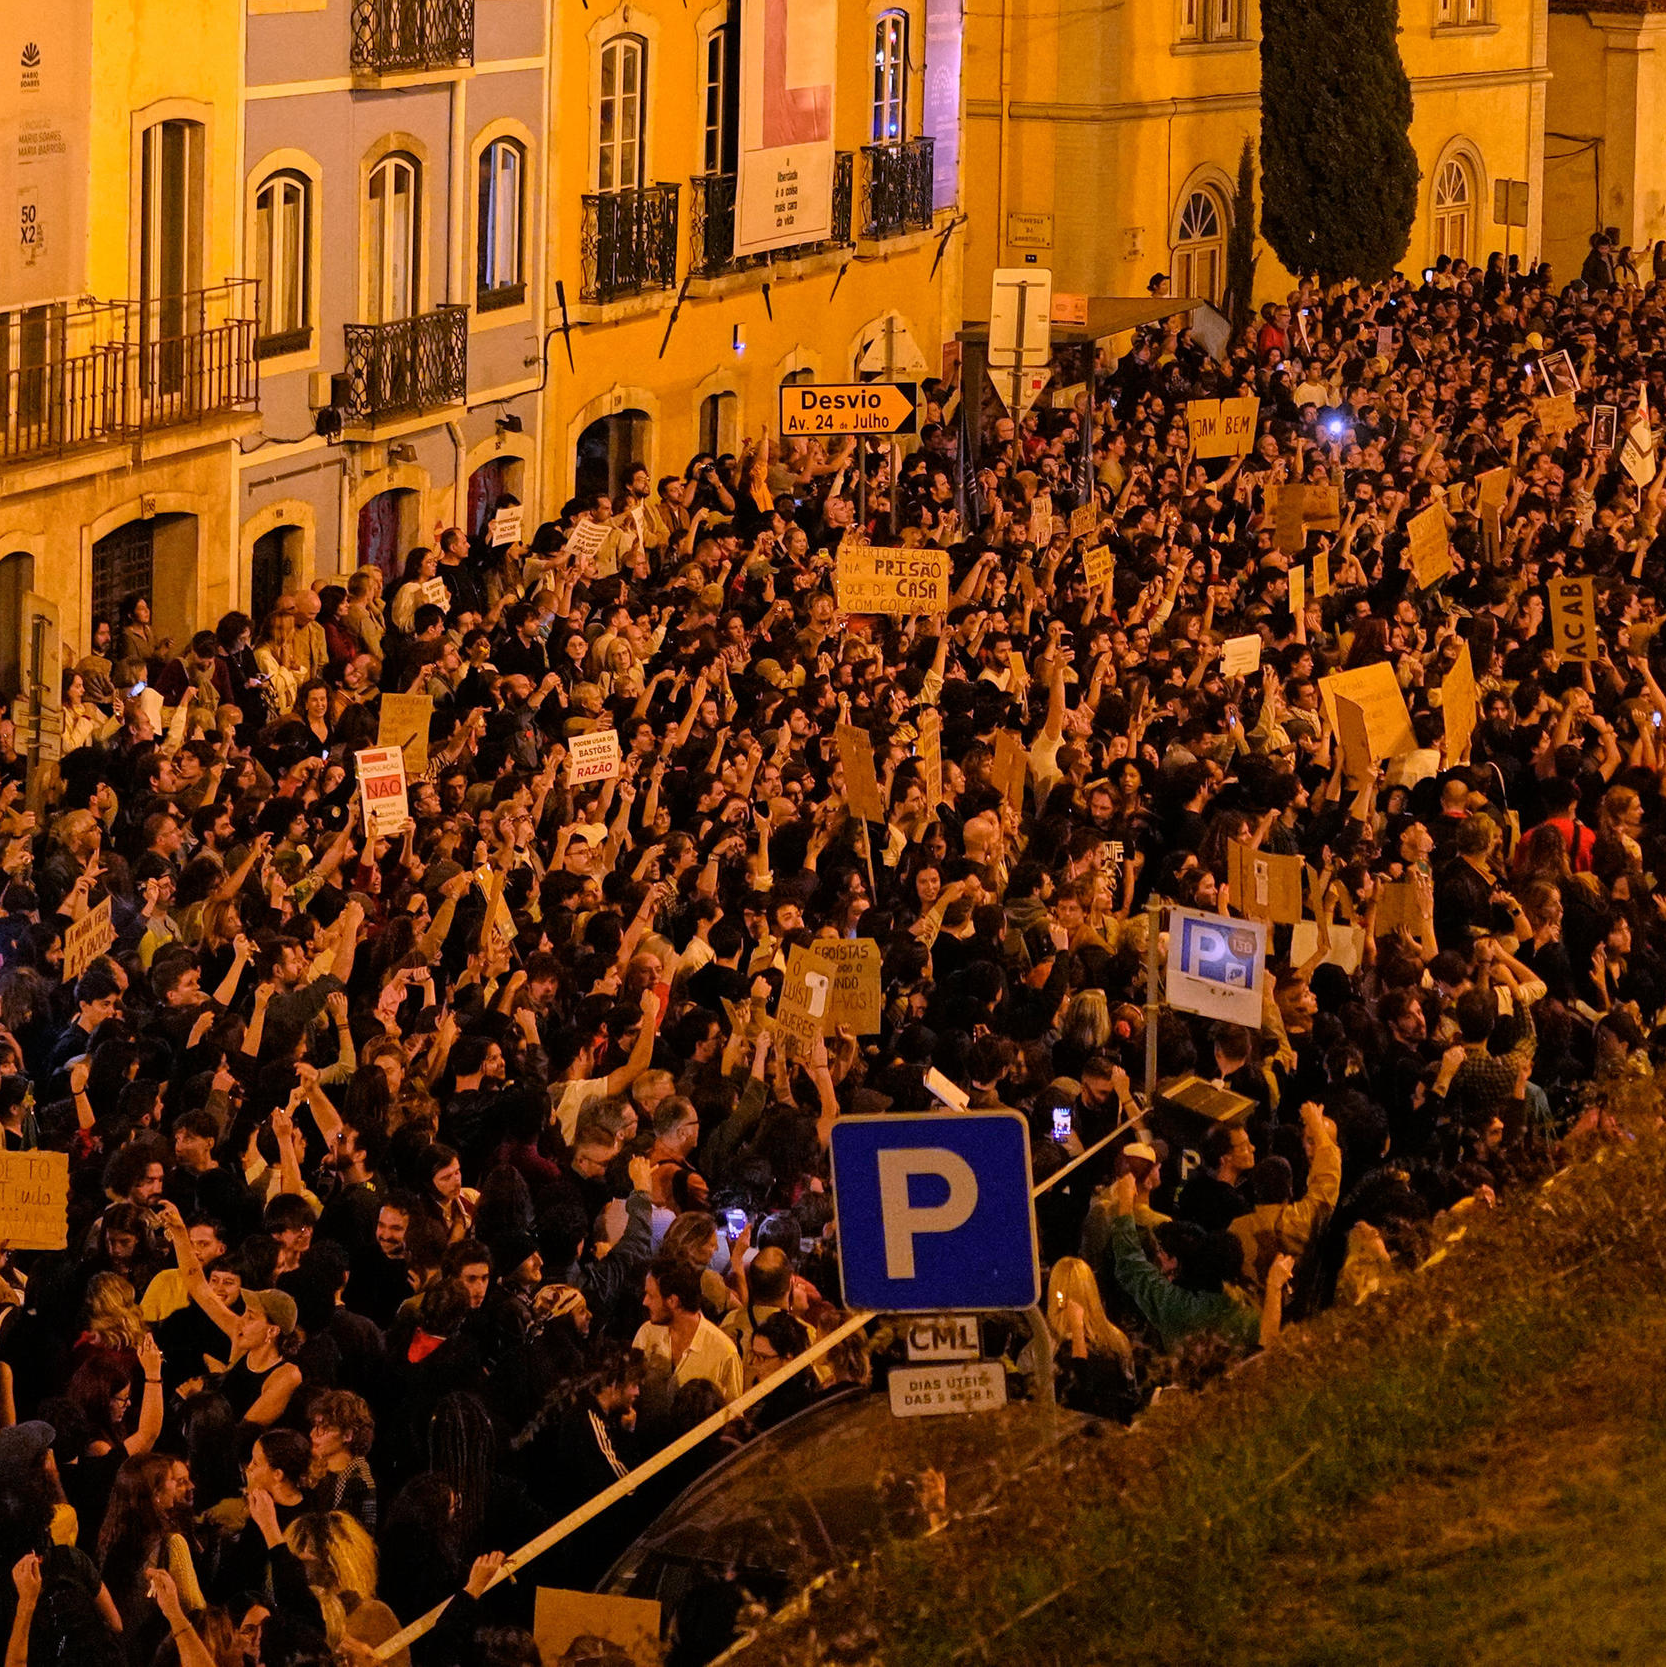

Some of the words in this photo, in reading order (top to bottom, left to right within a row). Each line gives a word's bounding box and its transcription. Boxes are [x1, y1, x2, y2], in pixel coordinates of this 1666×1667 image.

[21, 205, 36, 224] 50
[20, 225, 36, 245] X2
[801, 389, 881, 411] Desvio
[788, 415, 810, 431] Av.
[815, 414, 833, 430] 24
[840, 422, 848, 430] de
[853, 413, 890, 430] Julho
[1225, 415, 1251, 435] BEM
[875, 559, 942, 579] PRISÃO
[895, 579, 938, 599] CASA
[1560, 582, 1588, 659] ACAB
[579, 743, 612, 758] BASTÕES
[577, 761, 613, 778] RAZÃO
[1189, 924, 1226, 976] P
[878, 1147, 979, 1280] P
[909, 1324, 979, 1352] CML
[909, 1379, 941, 1392] DIAS
